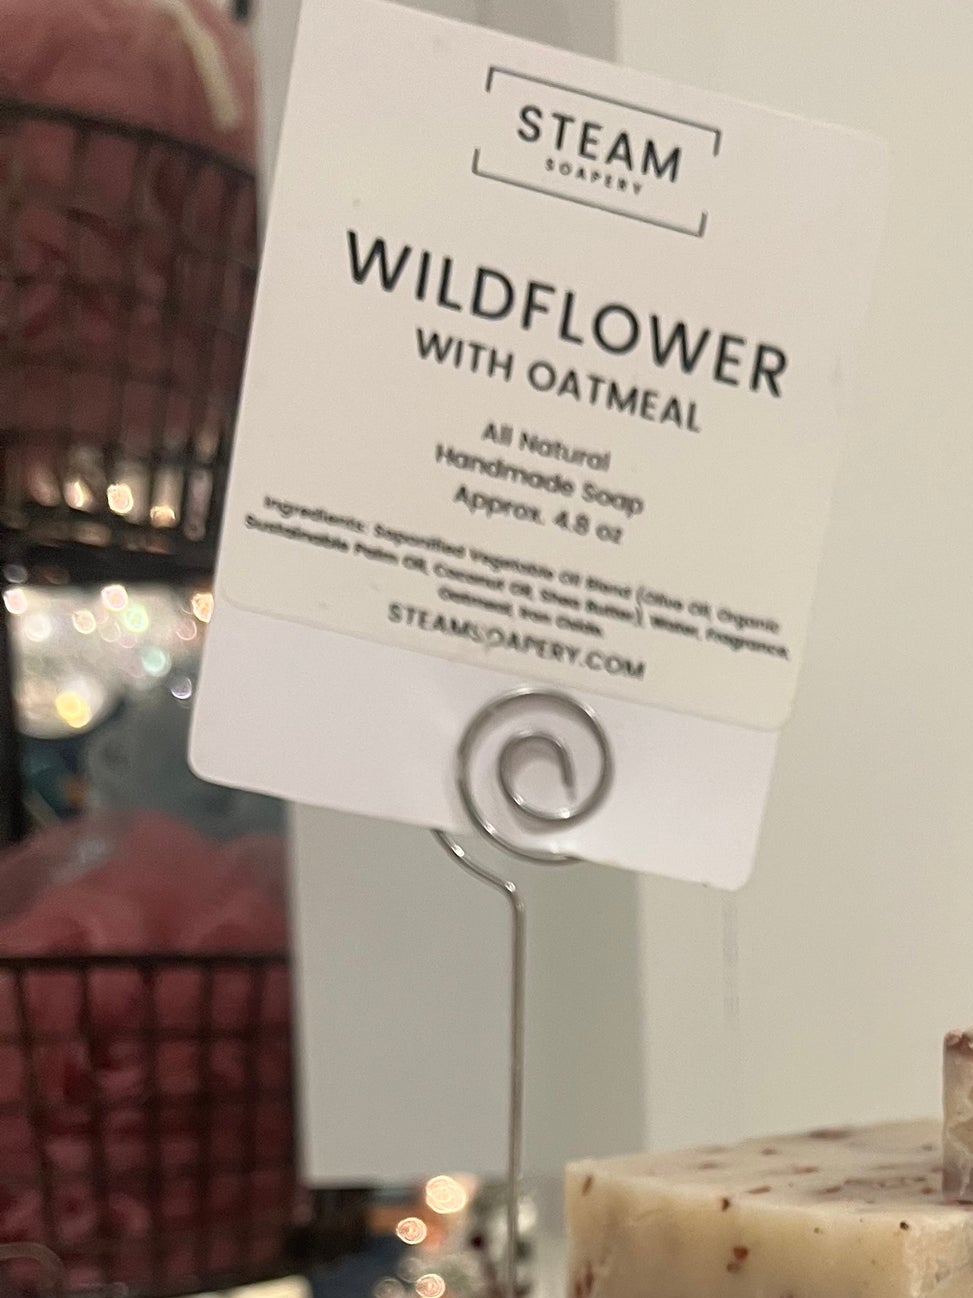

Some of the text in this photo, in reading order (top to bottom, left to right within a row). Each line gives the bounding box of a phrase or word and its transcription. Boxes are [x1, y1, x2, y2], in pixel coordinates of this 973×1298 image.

[516, 104, 683, 183] STEAM
[545, 157, 643, 195] SOAPERY
[346, 229, 788, 399] WILDFLOWER
[416, 327, 702, 434] WITH OATMEAL
[435, 442, 646, 518] Handmade Soap
[481, 422, 612, 472] All Natural
[453, 484, 624, 545] Approx. 4.8 oz
[388, 601, 646, 681] STEAMSOAPERY.COM
